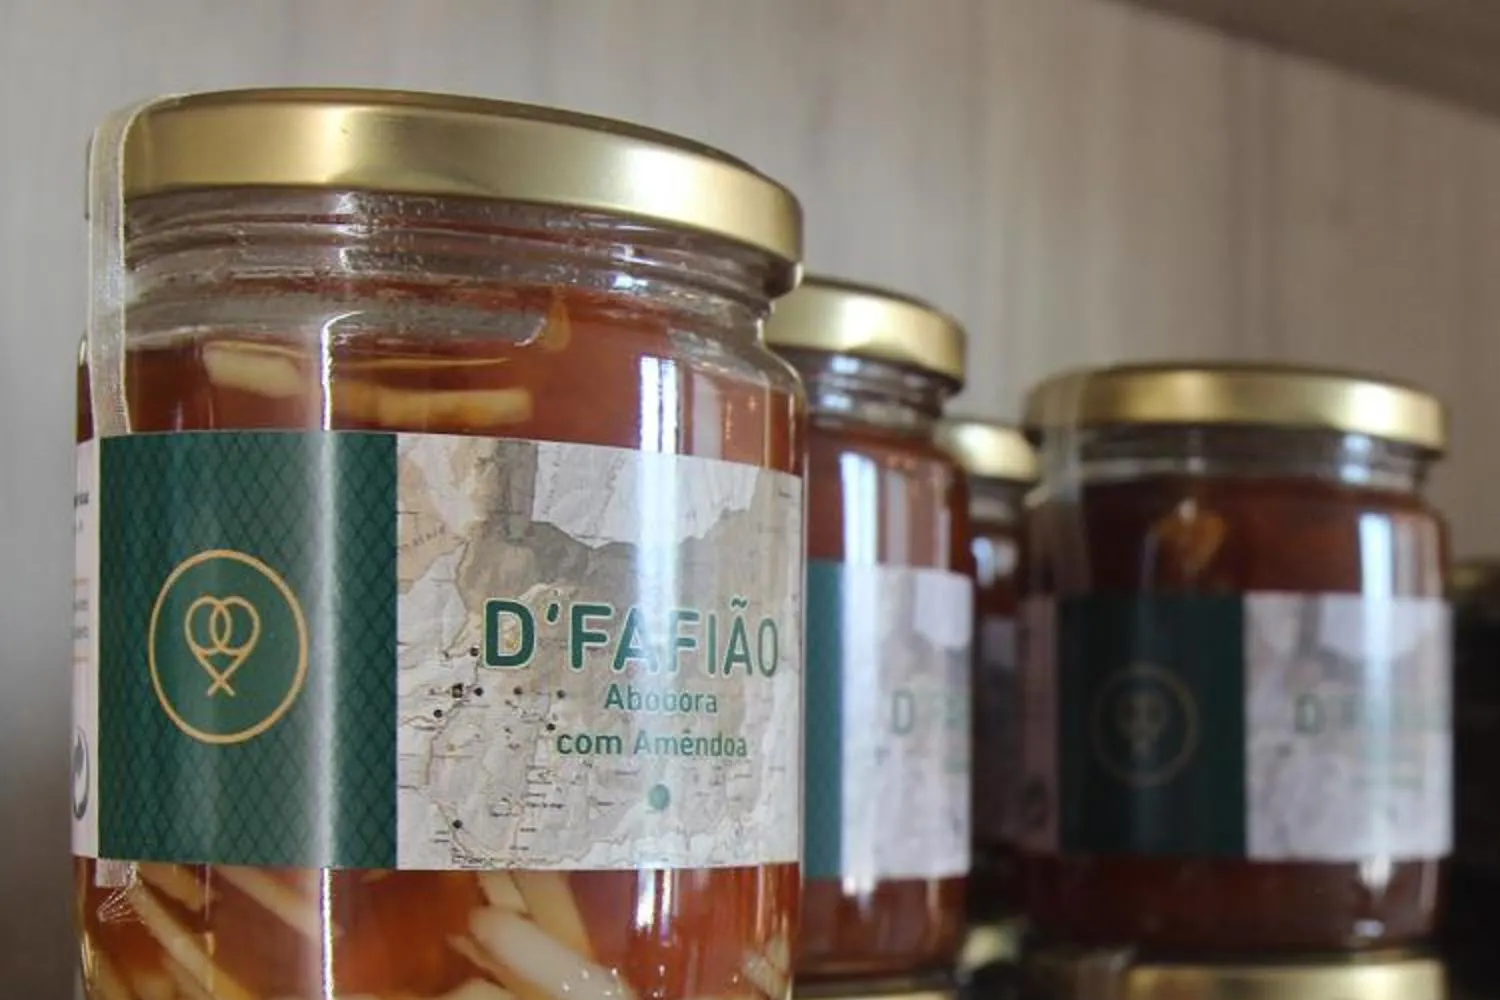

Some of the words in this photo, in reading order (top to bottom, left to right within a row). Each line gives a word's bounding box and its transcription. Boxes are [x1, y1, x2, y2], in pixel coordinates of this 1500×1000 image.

[484, 597, 779, 678] D'FAFIÃO
[556, 732, 623, 755] com
[632, 729, 749, 758] Amêndoa
